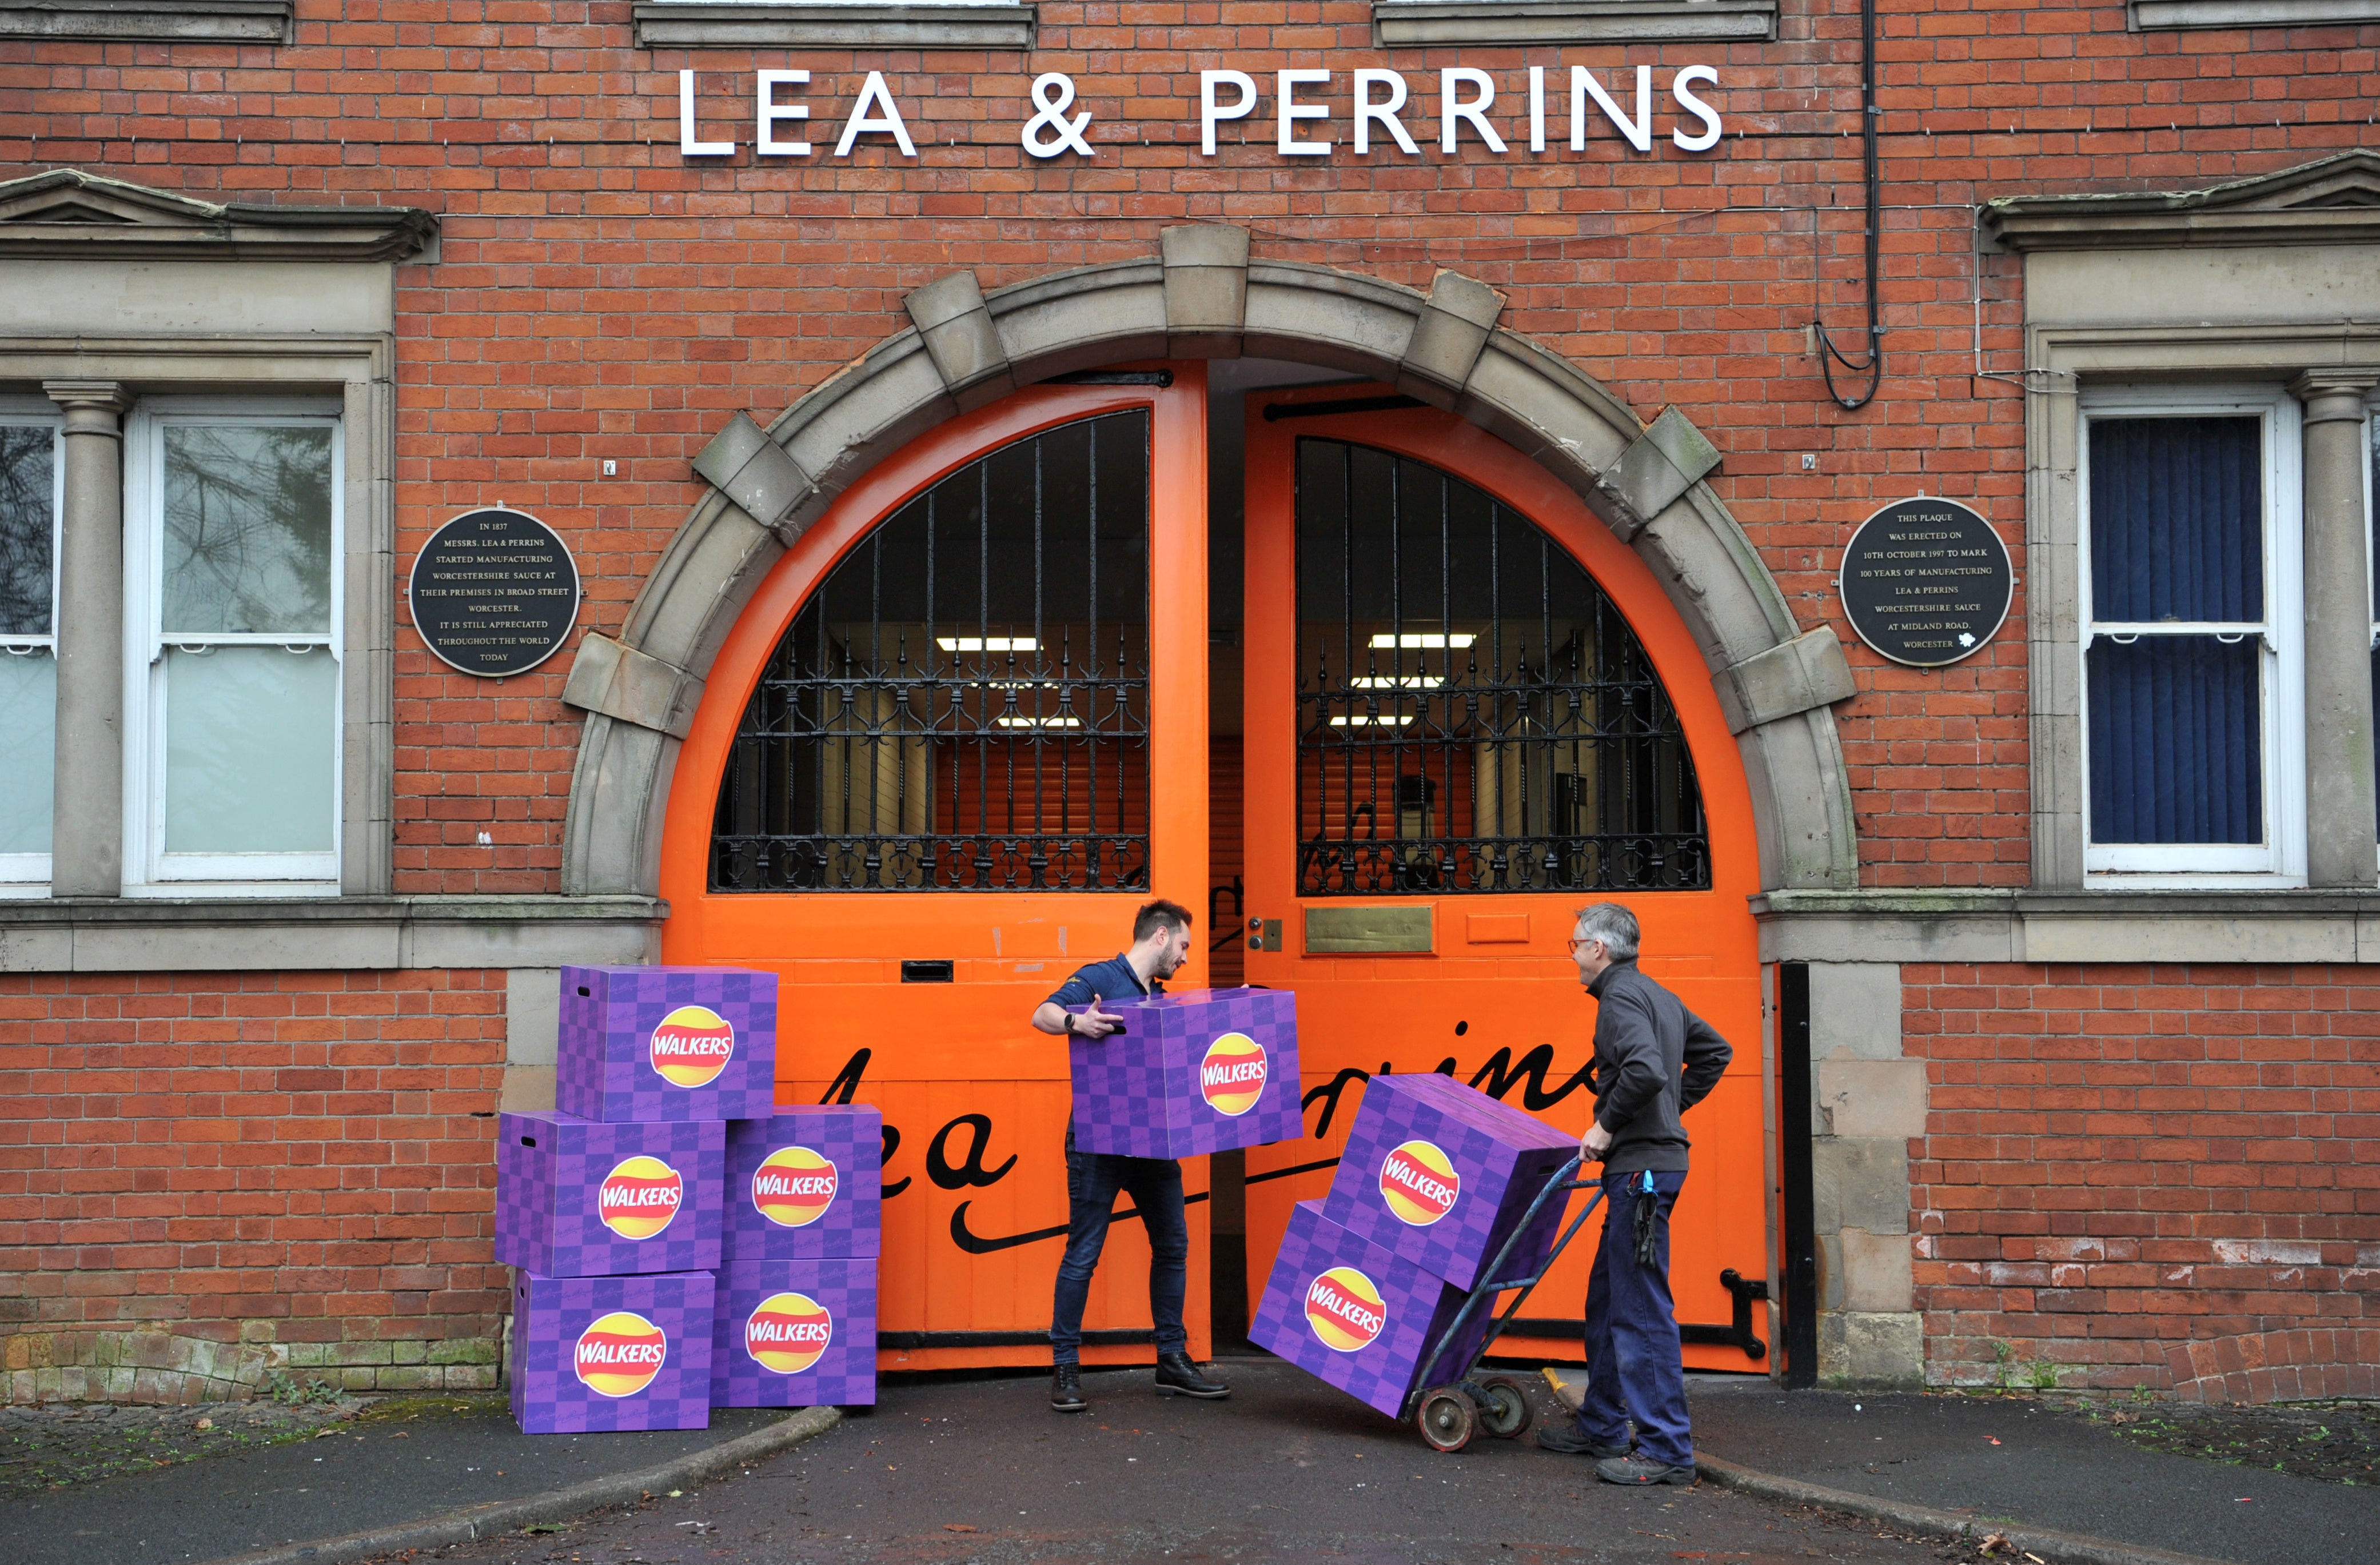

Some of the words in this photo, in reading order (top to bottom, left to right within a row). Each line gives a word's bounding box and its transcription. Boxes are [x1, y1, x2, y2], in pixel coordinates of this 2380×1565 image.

[680, 69, 917, 155] LEA
[1021, 72, 1095, 157] &
[1201, 65, 1721, 155] PERRINS
[1897, 514, 1917, 522] THIS
[1920, 514, 1953, 522] PLAQUE
[1908, 532, 1947, 541] ERECTED
[1887, 550, 1927, 558] OCTOBER
[1929, 550, 1944, 558] 1997
[1947, 549, 1958, 557] TO
[1960, 549, 1988, 557] MARK
[1919, 567, 1992, 576] MANUFACTURING
[1923, 586, 1959, 594] PERRINS
[1875, 604, 1951, 613] WORCESTERSHIRE
[1901, 622, 1942, 630] MIDLAND
[437, 637, 497, 645] THROUGHOUT
[519, 637, 550, 645] WORLD
[1903, 640, 1953, 648] WORCESTER
[654, 1033, 731, 1055] WALKERS
[1203, 1060, 1265, 1087] WALKERS
[756, 1174, 835, 1195] WALKERS
[1385, 1157, 1455, 1207] WALKERS
[603, 1184, 680, 1207] WALKERS
[1310, 1283, 1382, 1333] WALKERS
[750, 1320, 828, 1342] WALKERS
[579, 1341, 663, 1363] WALKERS
